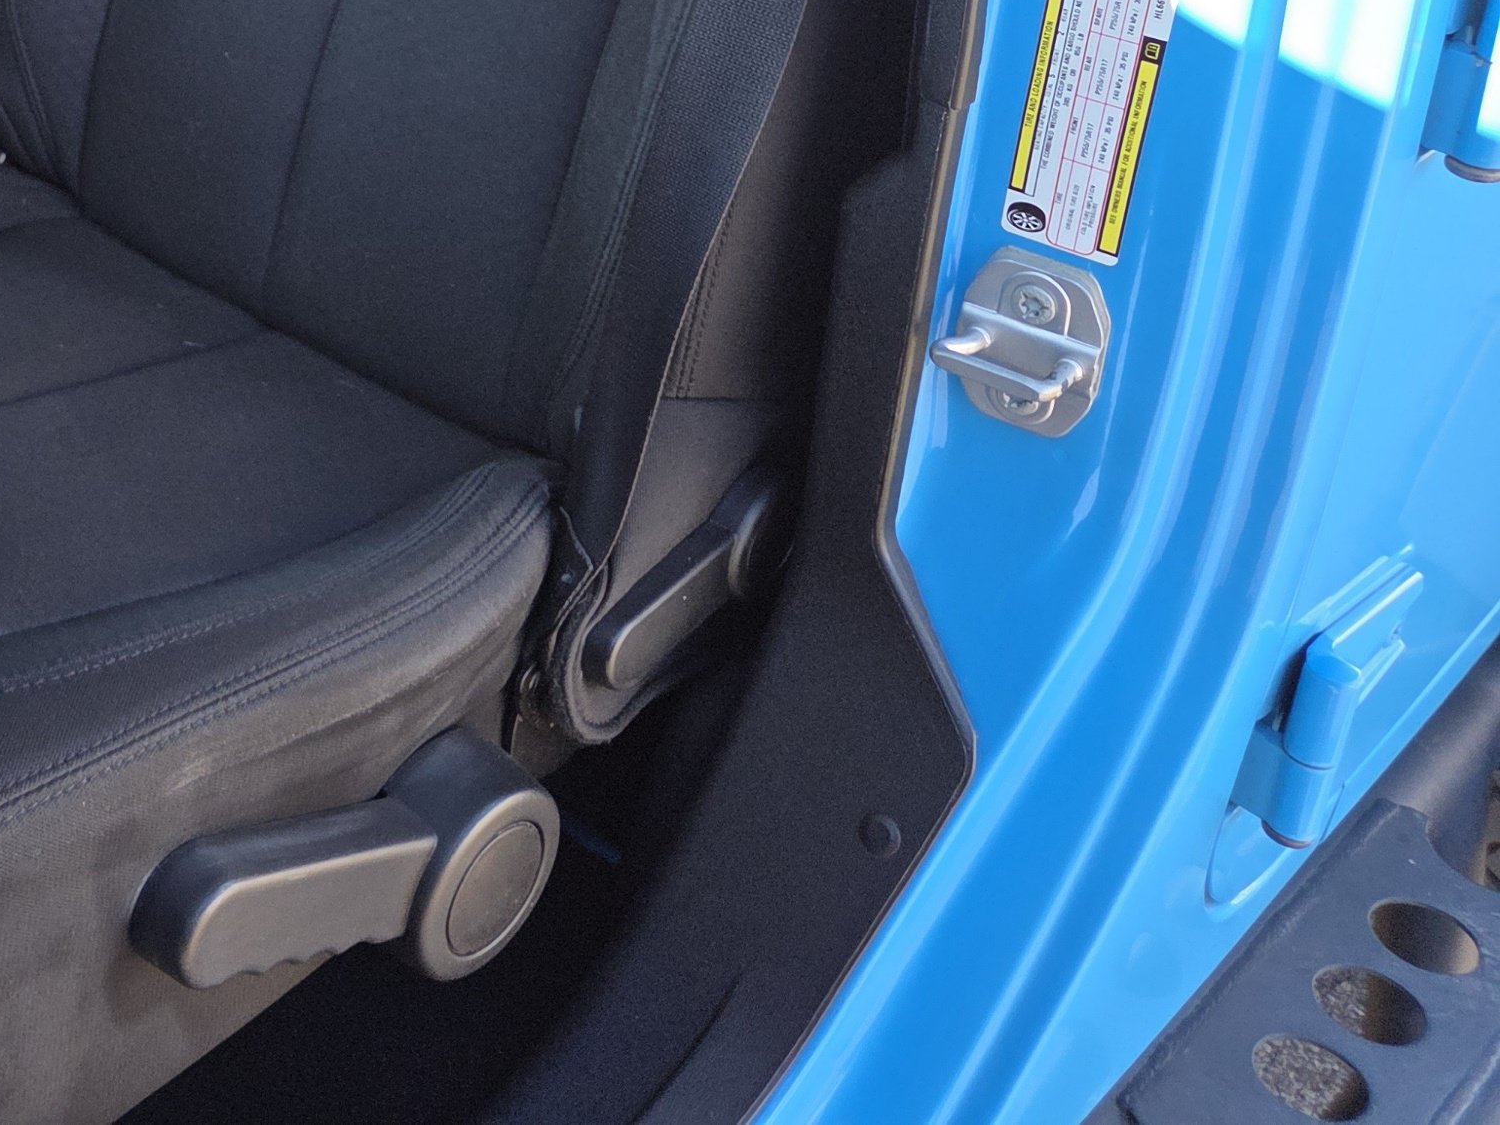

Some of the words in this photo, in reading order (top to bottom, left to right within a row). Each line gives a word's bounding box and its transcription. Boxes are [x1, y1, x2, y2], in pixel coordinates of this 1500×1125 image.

[1070, 8, 1080, 31] SHOULD
[1094, 7, 1103, 26] SPARE
[1039, 20, 1053, 66] INFORMATION
[1066, 31, 1075, 51] CARGO
[1063, 52, 1071, 64] AND
[1084, 55, 1092, 71] REAR
[1032, 67, 1044, 96] LOADING
[1056, 66, 1068, 99] OCCUPANTS
[1028, 96, 1037, 112] AND
[1134, 80, 1147, 119] INFORMATION
[1025, 113, 1034, 127] TIRE
[1050, 107, 1059, 129] WEIGHT
[1070, 115, 1079, 135] FRONT
[1044, 130, 1054, 158] COMBINED
[1125, 121, 1137, 152] ADDITIONAL
[1122, 153, 1130, 165] FOR
[1117, 167, 1127, 189] MANUAL
